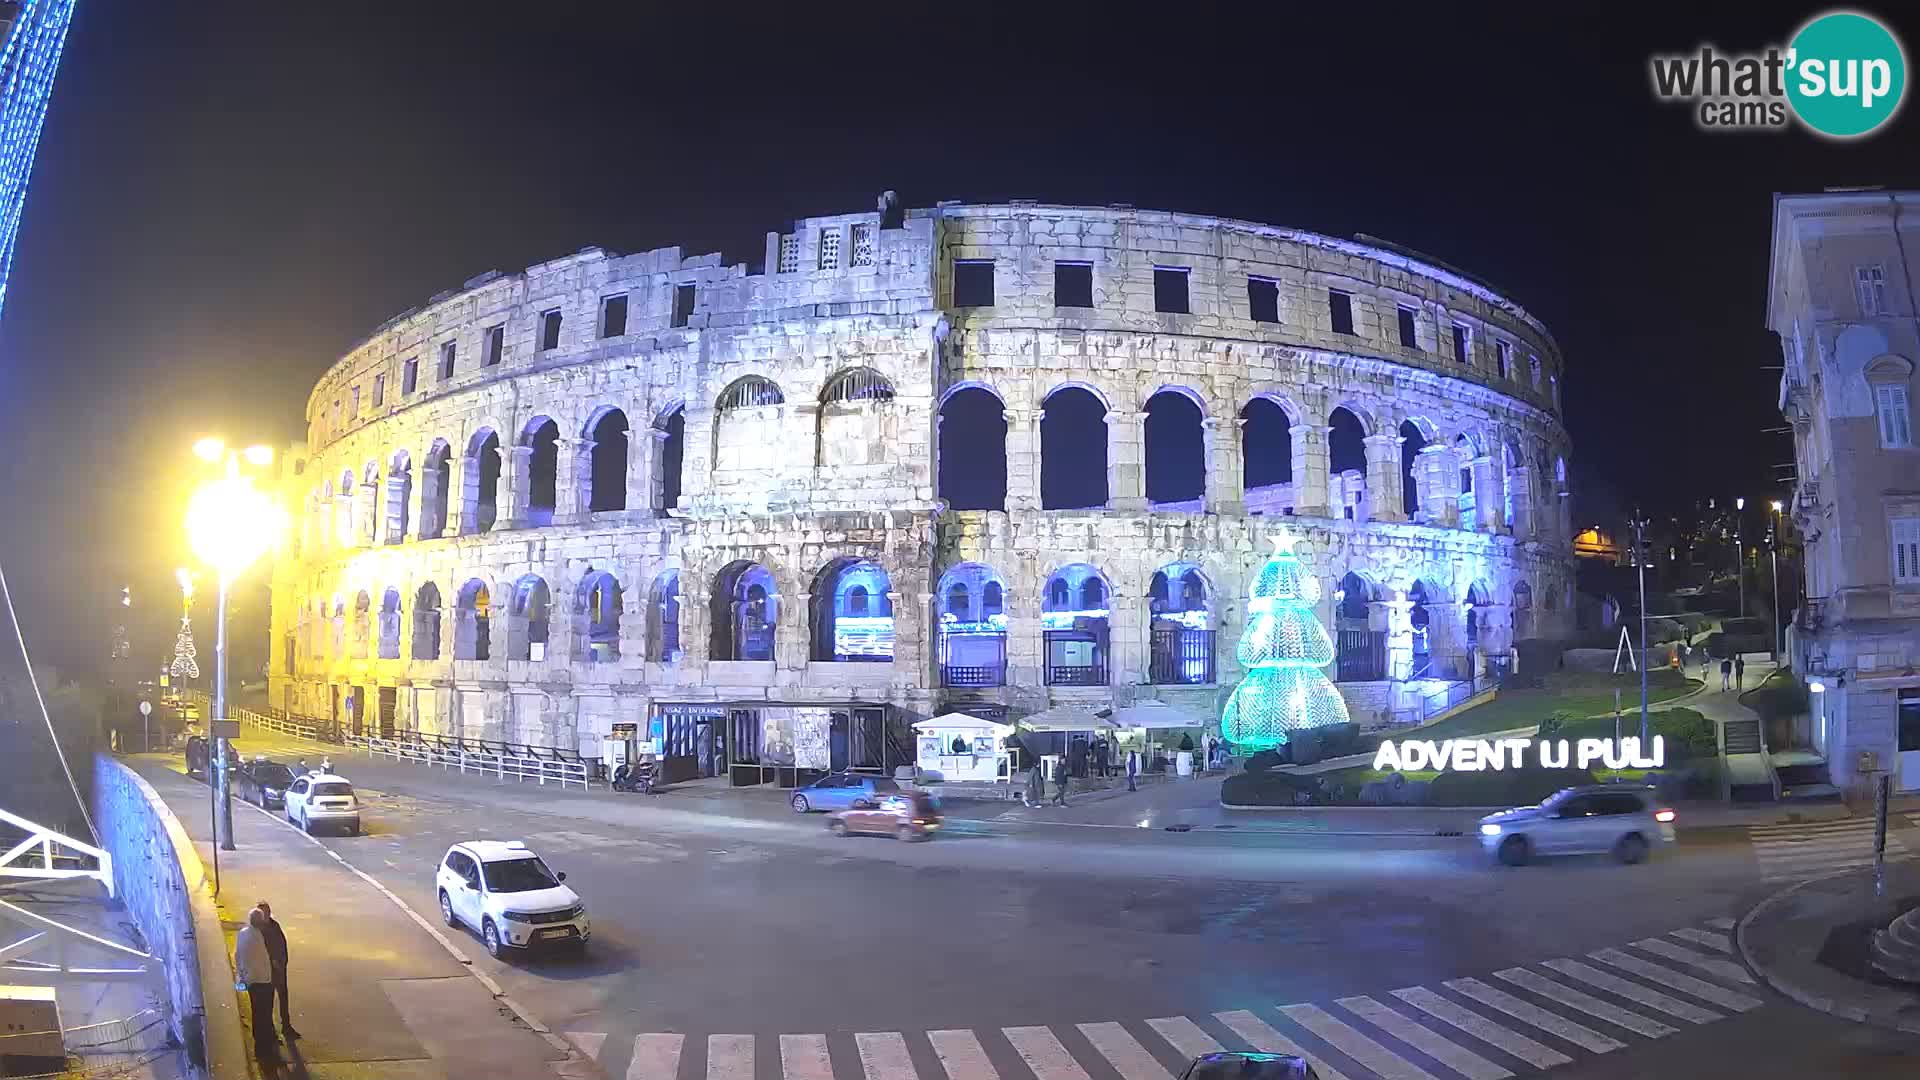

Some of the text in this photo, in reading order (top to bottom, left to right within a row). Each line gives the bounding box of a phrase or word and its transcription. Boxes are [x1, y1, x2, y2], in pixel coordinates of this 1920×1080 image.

[1373, 735, 1664, 771] ADVENT U PULI
